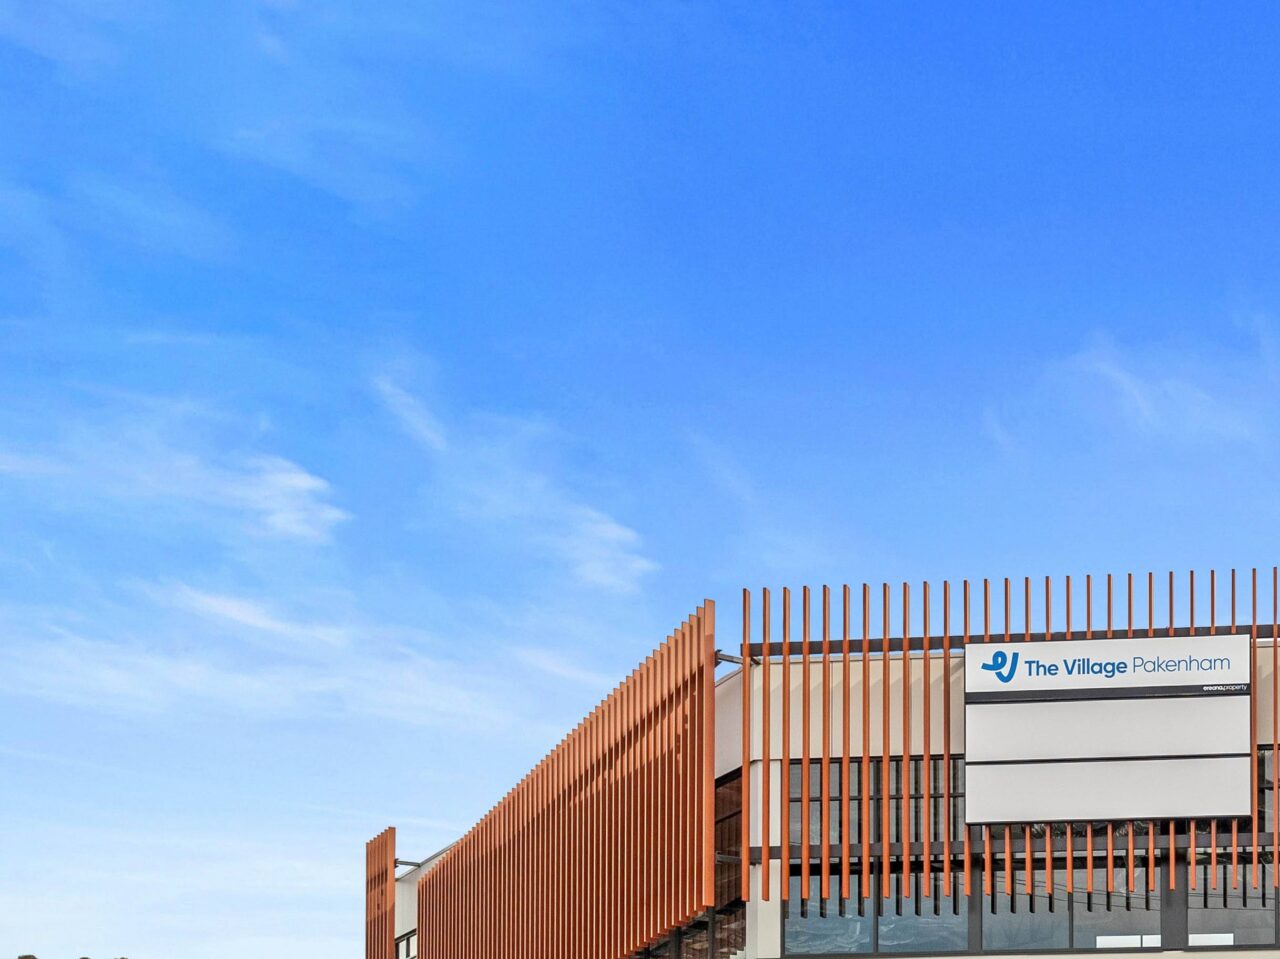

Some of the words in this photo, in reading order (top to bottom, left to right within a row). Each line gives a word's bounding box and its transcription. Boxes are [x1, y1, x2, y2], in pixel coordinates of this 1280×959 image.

[1024, 659, 1059, 677] The
[1063, 658, 1128, 678] Village
[1132, 655, 1231, 674] Pakenham
